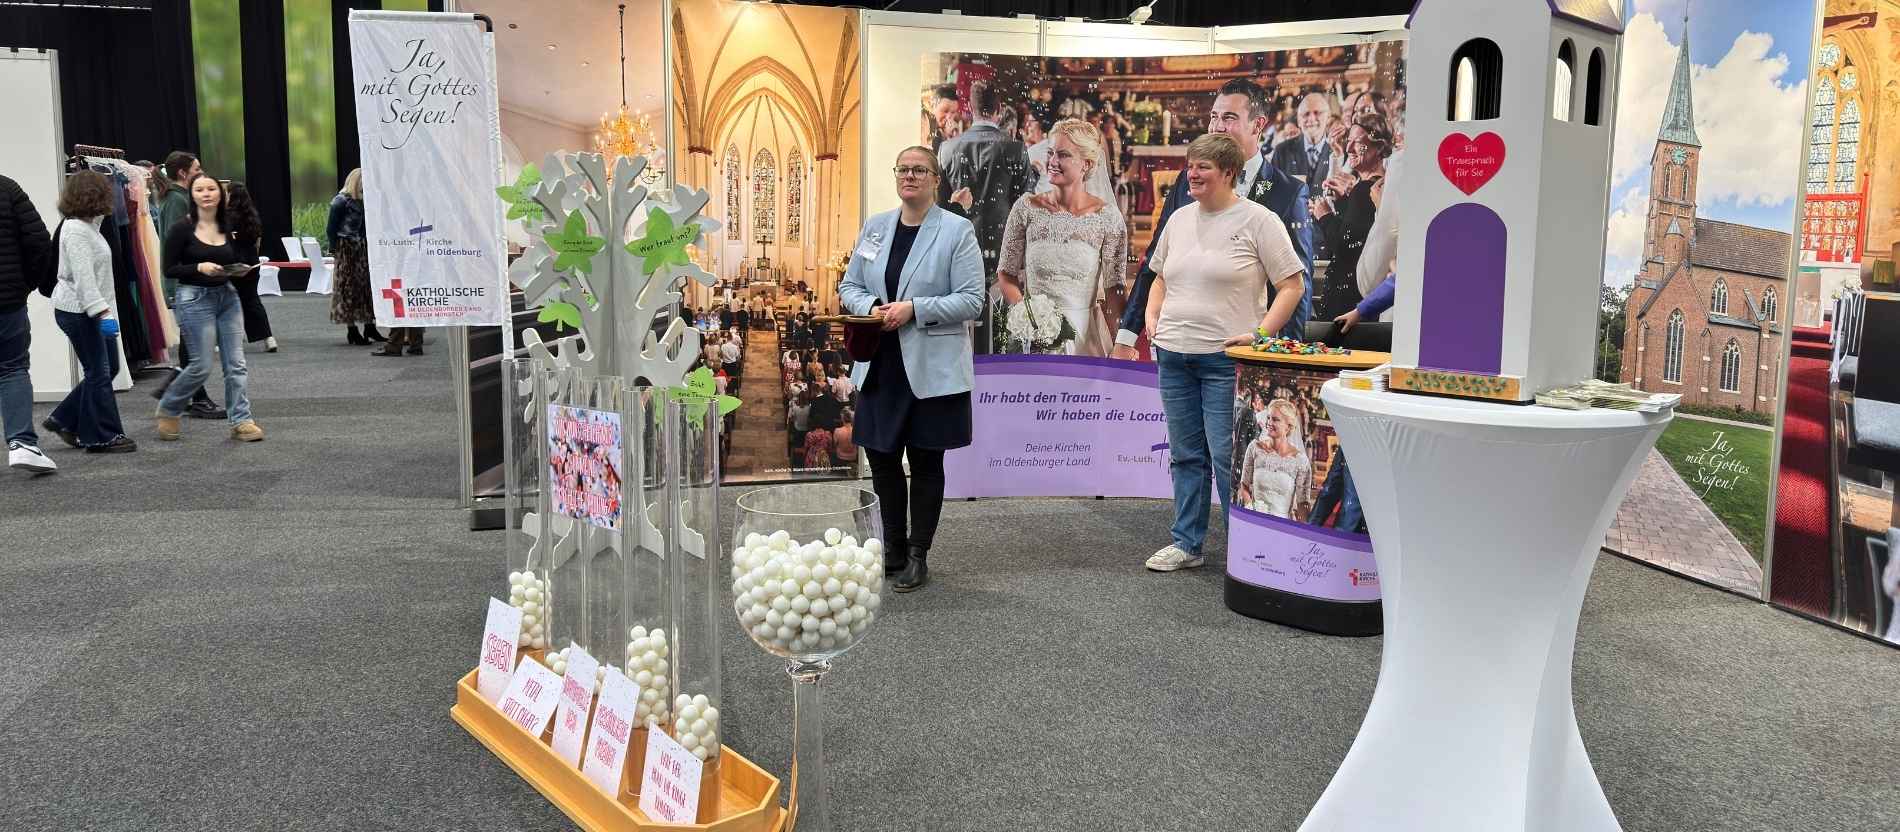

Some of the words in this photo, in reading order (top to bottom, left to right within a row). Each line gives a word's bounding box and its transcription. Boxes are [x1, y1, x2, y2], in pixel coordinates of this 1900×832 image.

[390, 38, 446, 74] Ja,
[360, 76, 400, 96] mit
[407, 73, 479, 108] Gottes
[380, 98, 463, 150] Segen!
[1464, 145, 1478, 153] Ein
[1447, 156, 1495, 167] Trauspruch
[1456, 168, 1469, 177] für
[1471, 168, 1484, 177] Sie
[426, 248, 435, 256] in
[436, 248, 482, 258] Oldenburg
[407, 287, 485, 297] KATHOLISCHE
[408, 297, 449, 307] KIRCHE
[979, 392, 999, 404] Ihr
[1000, 392, 1031, 404] habt
[1033, 392, 1057, 404] den
[1060, 392, 1101, 404] Traum
[1036, 409, 1057, 421] Wir
[1061, 409, 1101, 421] haben
[1105, 409, 1125, 421] die
[1025, 443, 1053, 454] Deine
[1054, 442, 1091, 454] Kirchen
[1701, 431, 1734, 456] Ja,
[1003, 457, 1065, 469] Oldenburger
[1066, 457, 1091, 467] Land
[1685, 452, 1706, 465] mit
[1709, 454, 1750, 475] Gottes
[1691, 466, 1740, 499] Segen!
